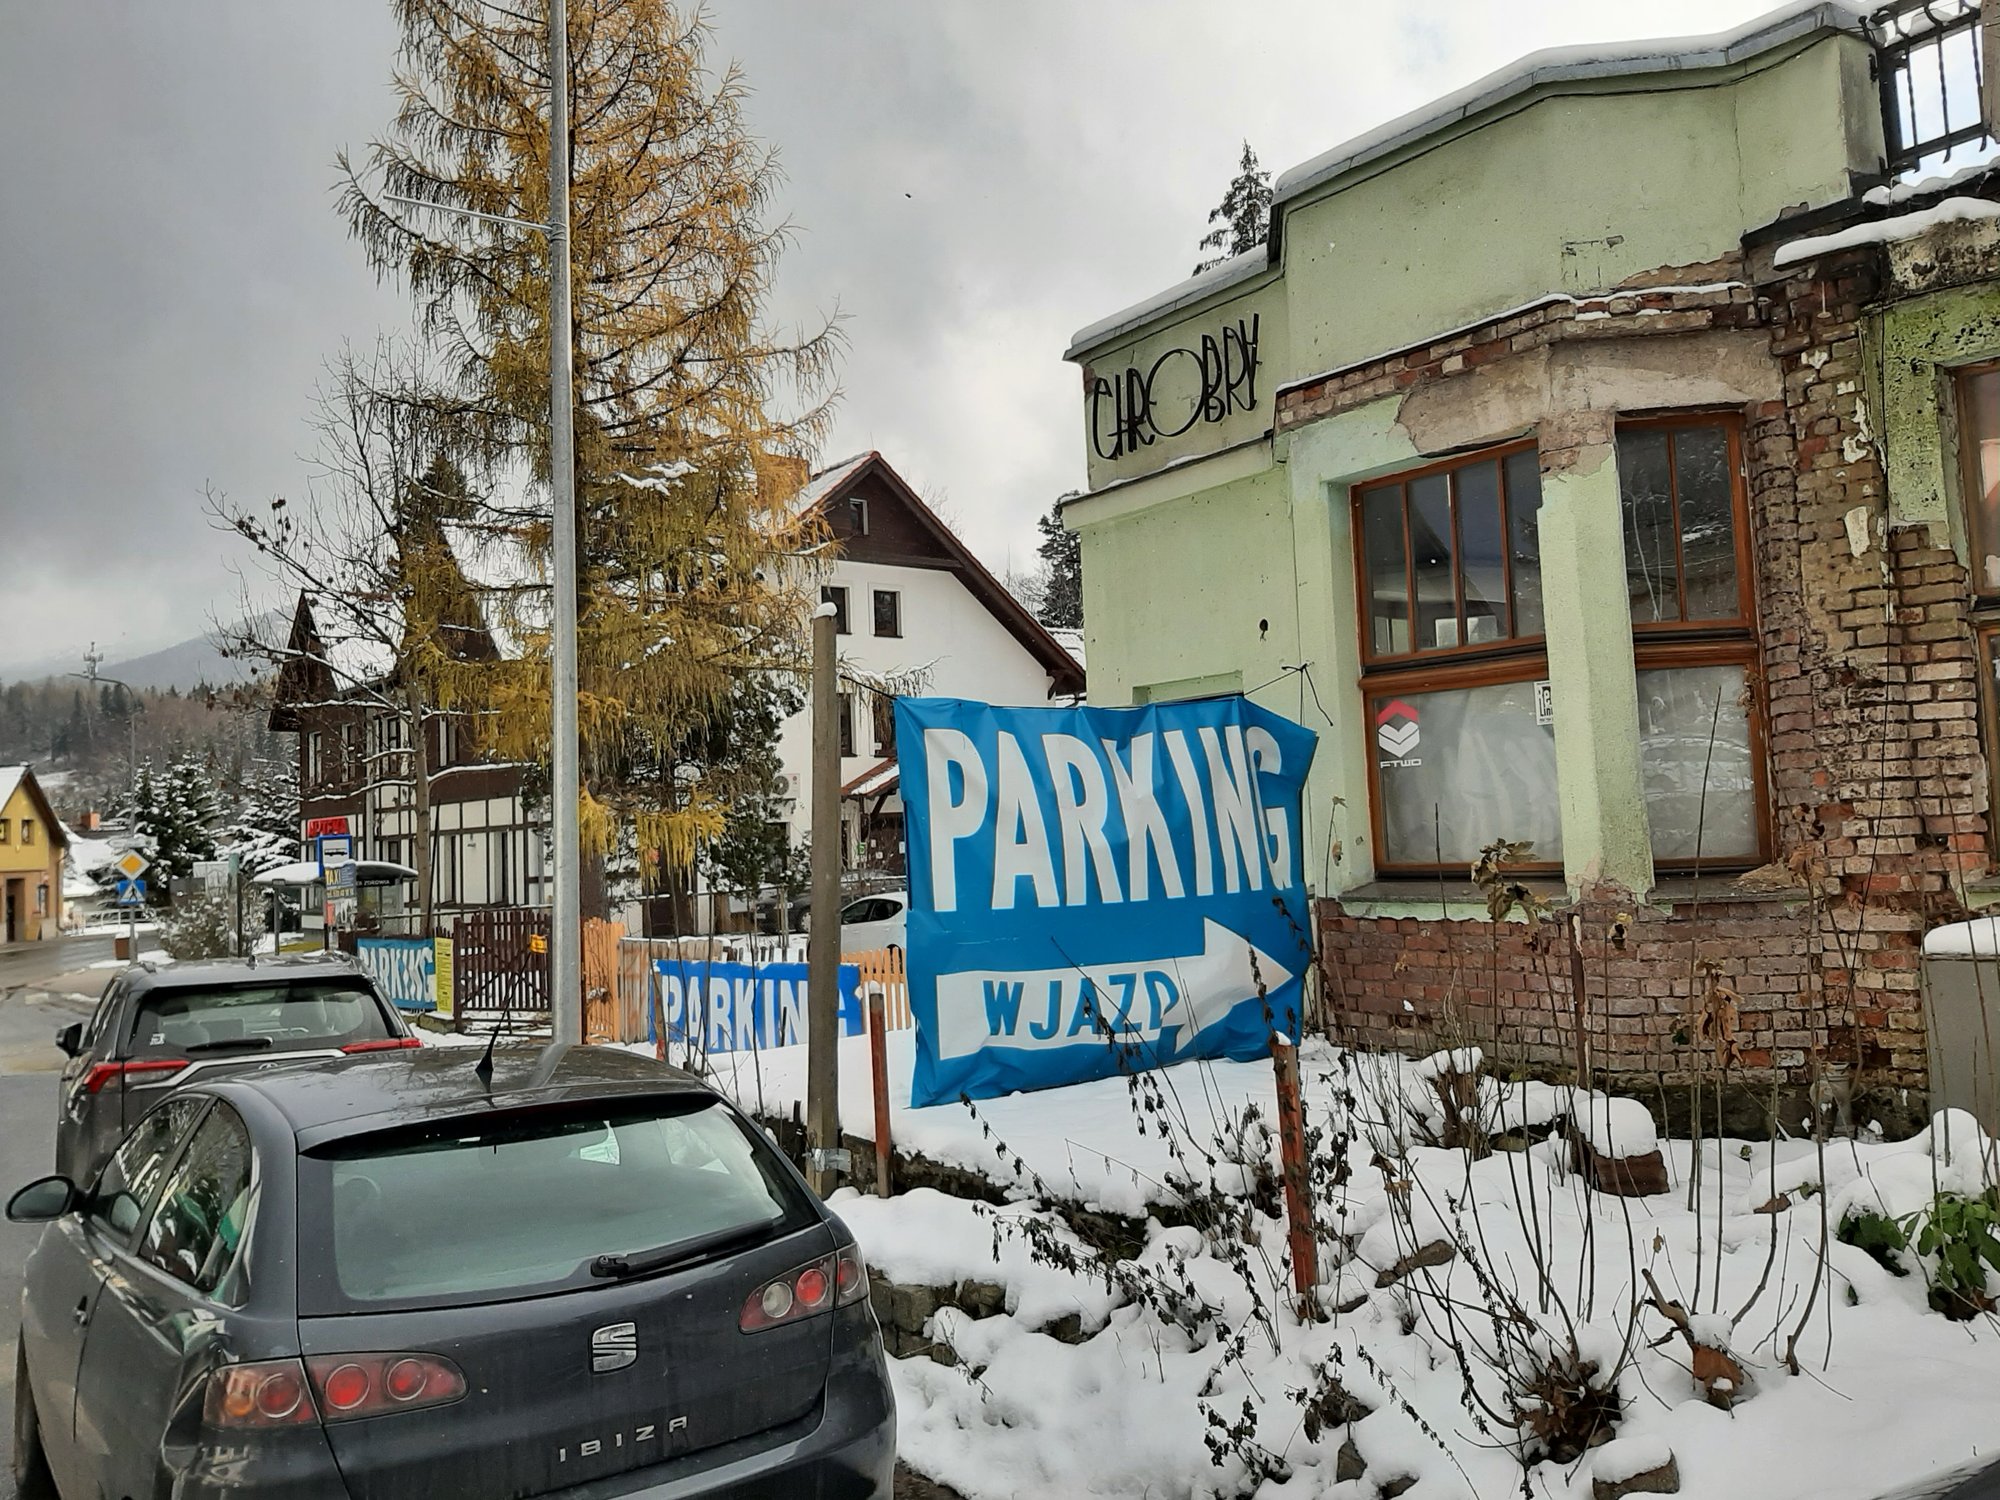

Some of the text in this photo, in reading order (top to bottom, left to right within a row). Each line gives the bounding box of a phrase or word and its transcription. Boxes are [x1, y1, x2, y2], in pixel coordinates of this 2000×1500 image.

[1092, 313, 1262, 460] CHROBRY
[924, 725, 1293, 912] PARKING
[325, 868, 342, 886] TAXI
[982, 970, 1181, 1041] WJAZD
[559, 1415, 688, 1462] IBIZA
